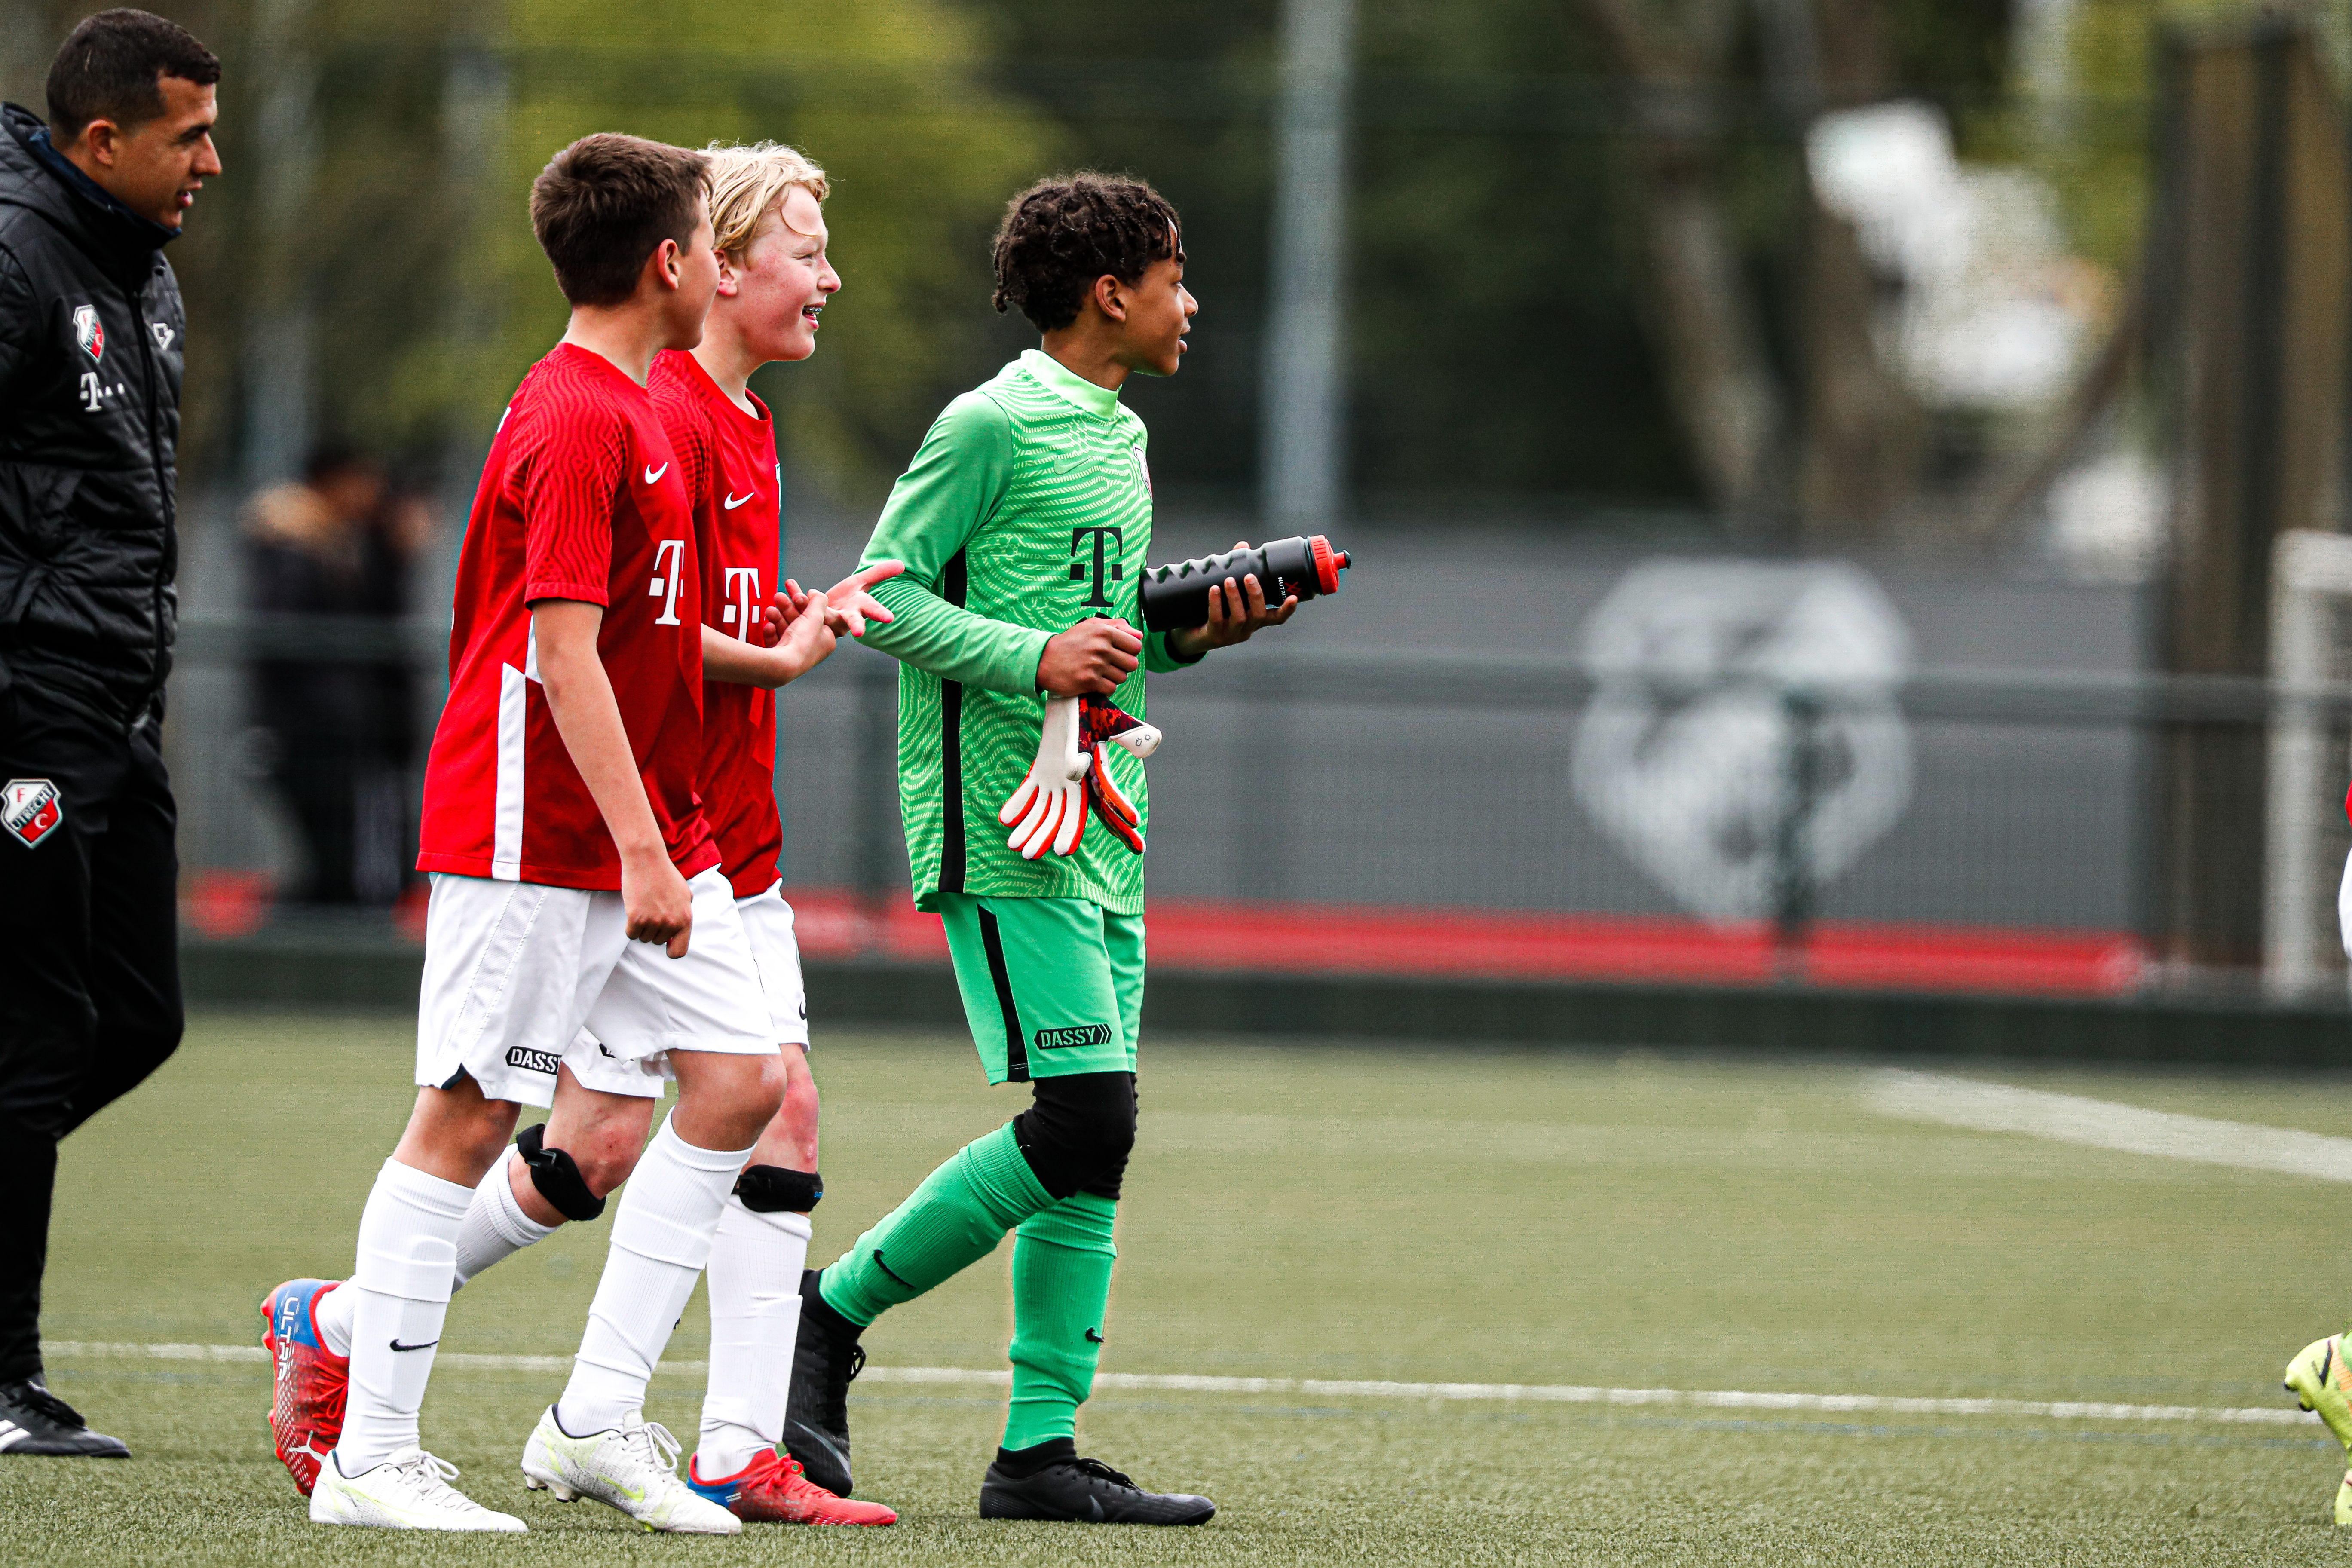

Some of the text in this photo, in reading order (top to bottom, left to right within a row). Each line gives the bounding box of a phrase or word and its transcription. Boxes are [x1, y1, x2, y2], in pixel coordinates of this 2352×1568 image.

[649, 540, 684, 625] T
[1069, 528, 1122, 607] T
[723, 567, 760, 643] T
[1277, 577, 1286, 600] NUTRIT
[10, 785, 55, 830] UTRECHT
[17, 787, 25, 802] F
[34, 812, 49, 830] C
[1041, 1027, 1096, 1047] DASSY
[510, 1048, 560, 1073] DASS
[277, 1296, 299, 1381] ULTRA
